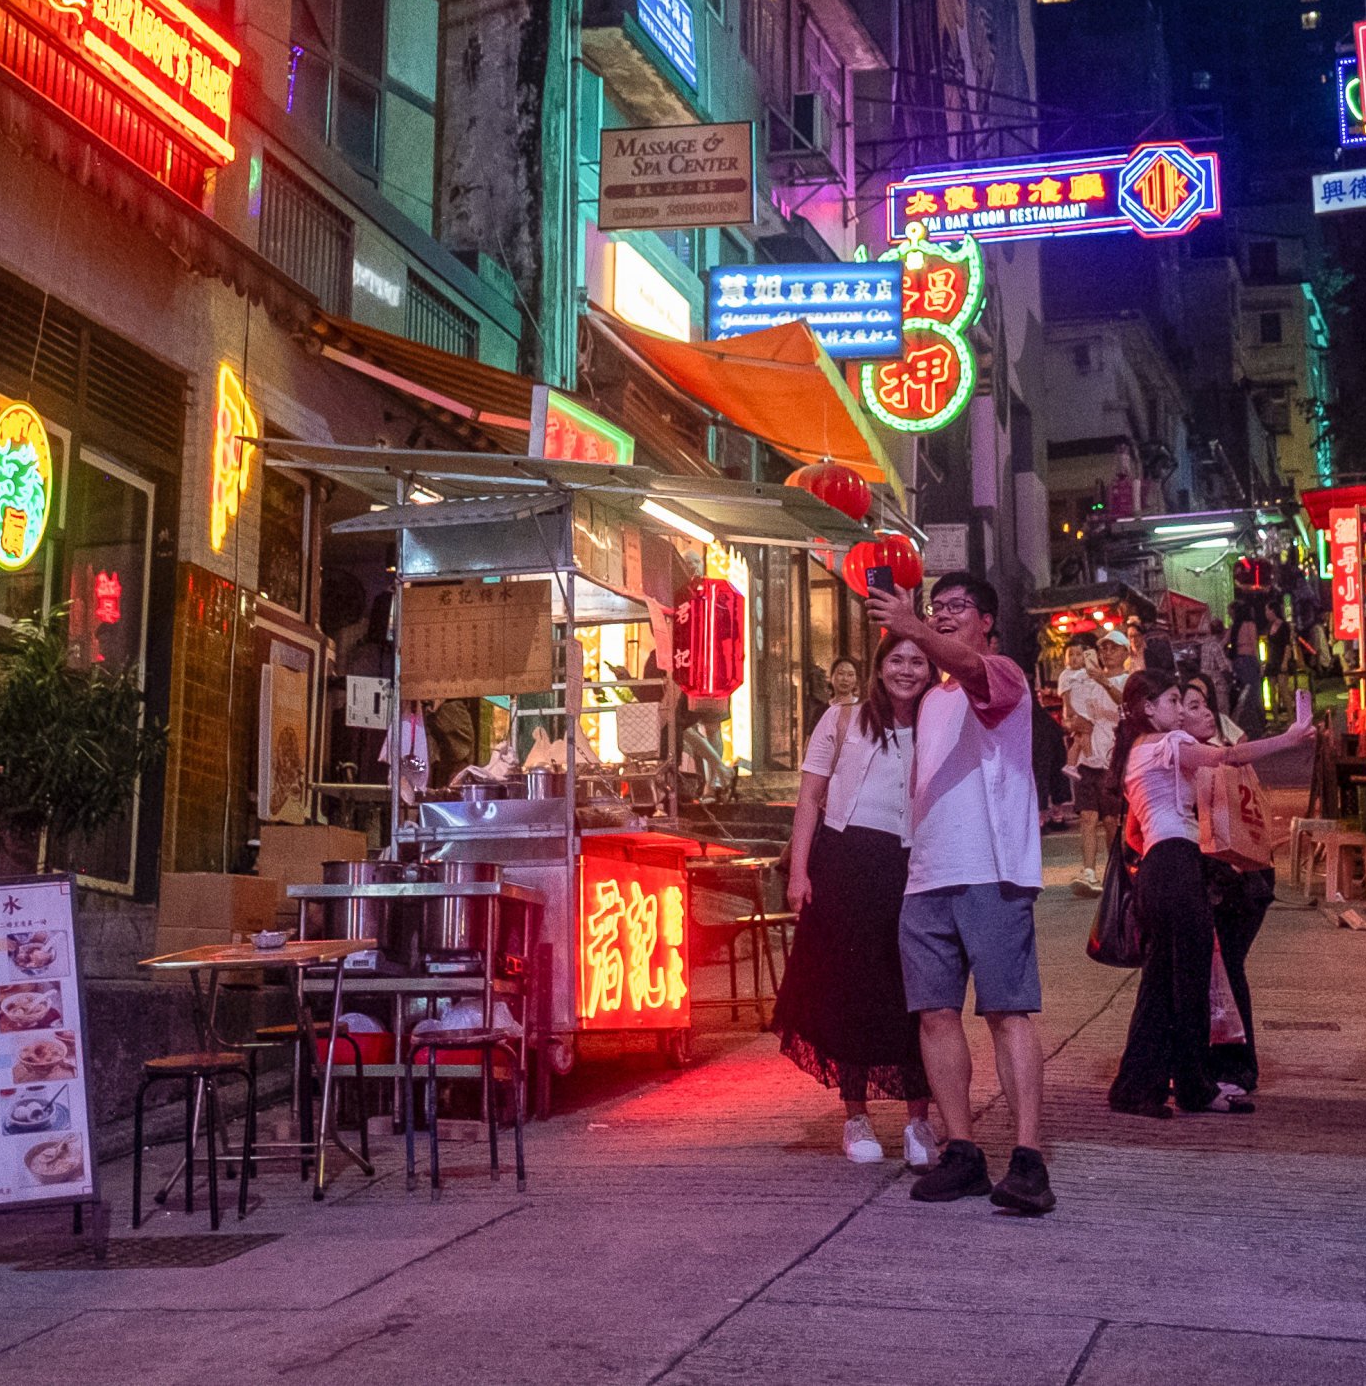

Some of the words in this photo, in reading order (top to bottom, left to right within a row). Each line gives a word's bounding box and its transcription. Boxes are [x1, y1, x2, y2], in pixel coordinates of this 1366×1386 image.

[614, 137, 697, 158] MASSAGE
[702, 132, 725, 153] &
[631, 156, 662, 178] SPA
[667, 154, 738, 175] CENTER
[1009, 202, 1087, 224] RESTAURANT
[879, 344, 952, 414] 押
[673, 601, 692, 670] 君記
